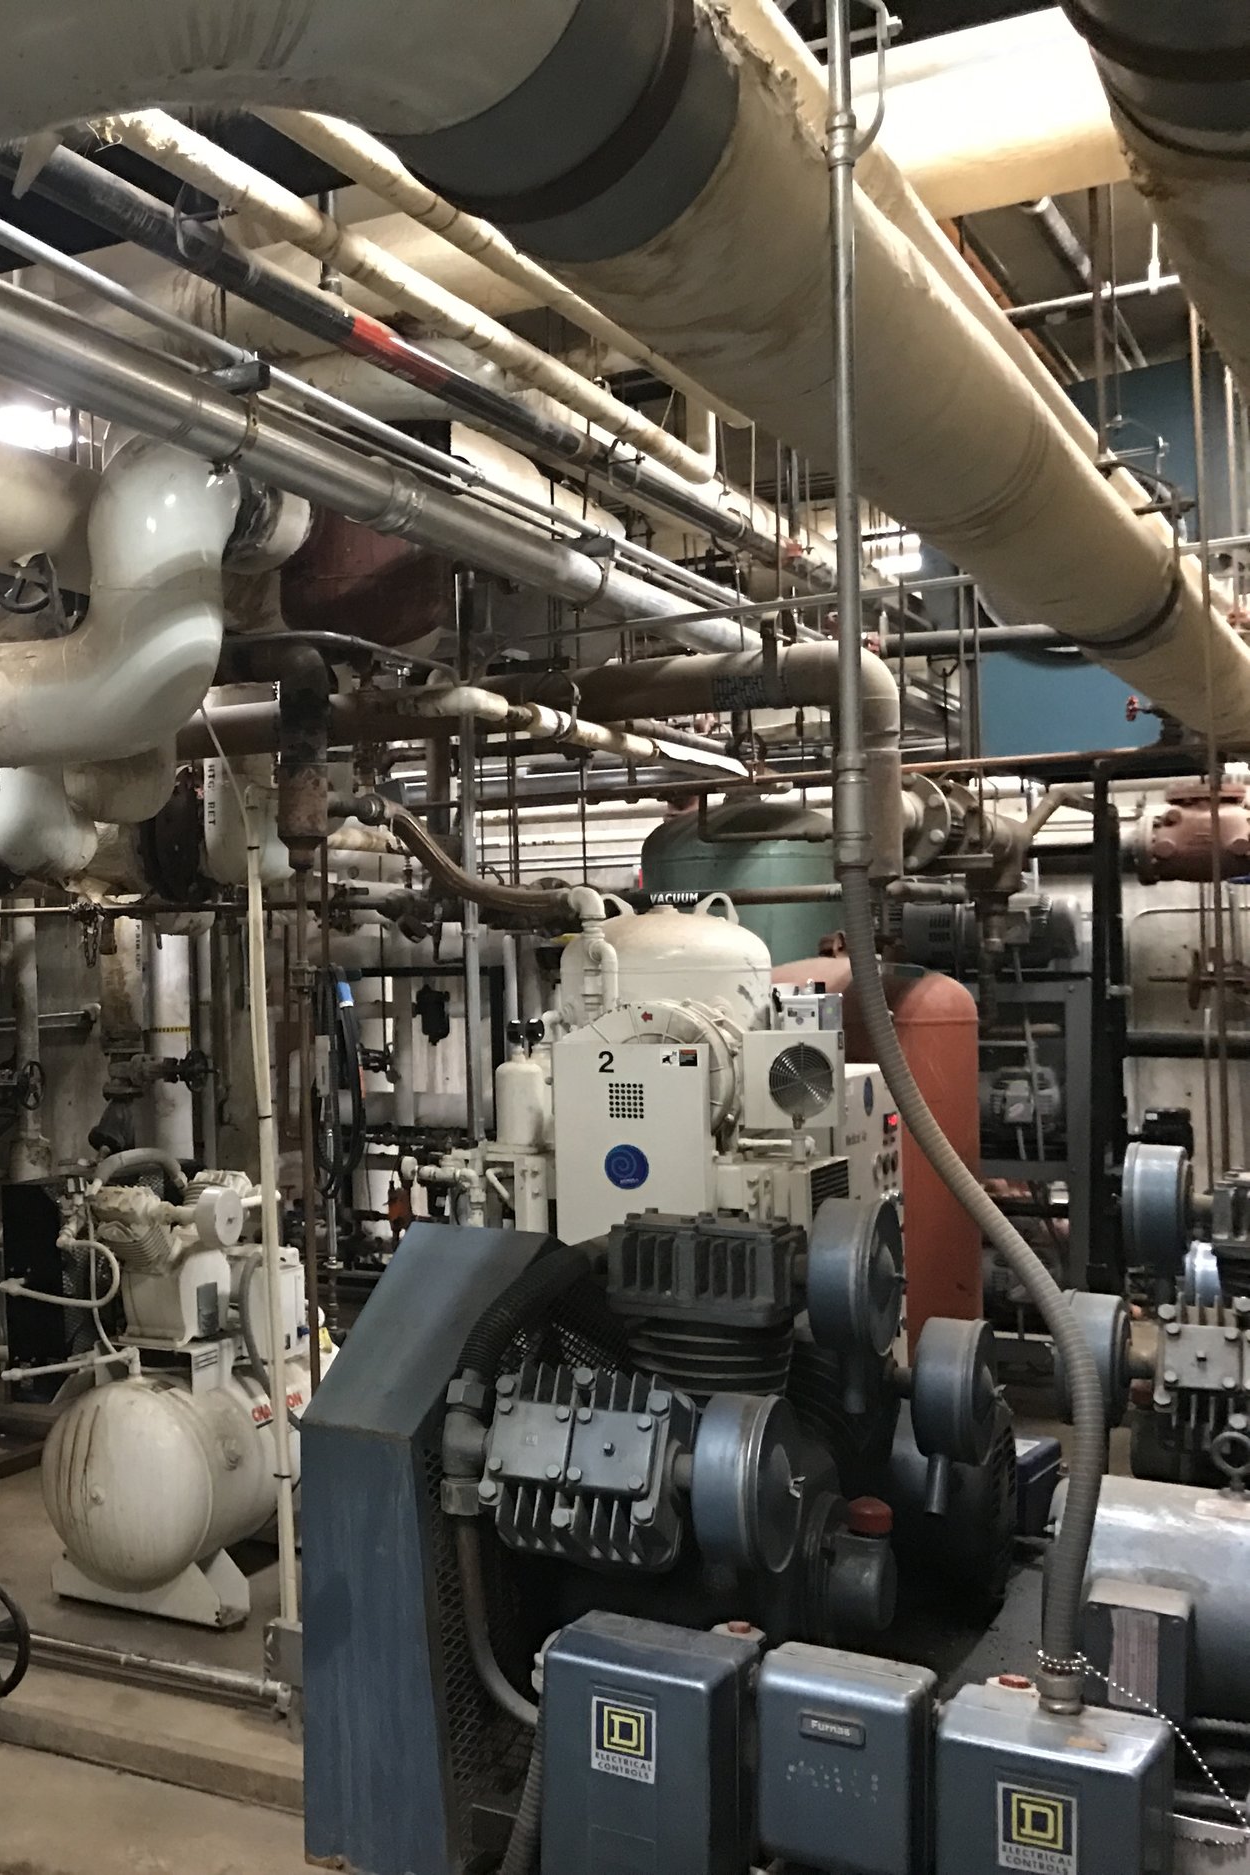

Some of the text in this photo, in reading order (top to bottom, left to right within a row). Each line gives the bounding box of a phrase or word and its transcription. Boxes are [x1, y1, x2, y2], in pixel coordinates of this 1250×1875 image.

[650, 892, 699, 904] VACUUM
[598, 1051, 614, 1073] 2
[811, 1719, 850, 1737] Furnas
[595, 1751, 652, 1772] ELECTRICAL
[598, 1761, 650, 1780] CONTROLS
[1001, 1844, 1072, 1867] ELECTRICAL
[1006, 1855, 1069, 1875] CONTROLS
